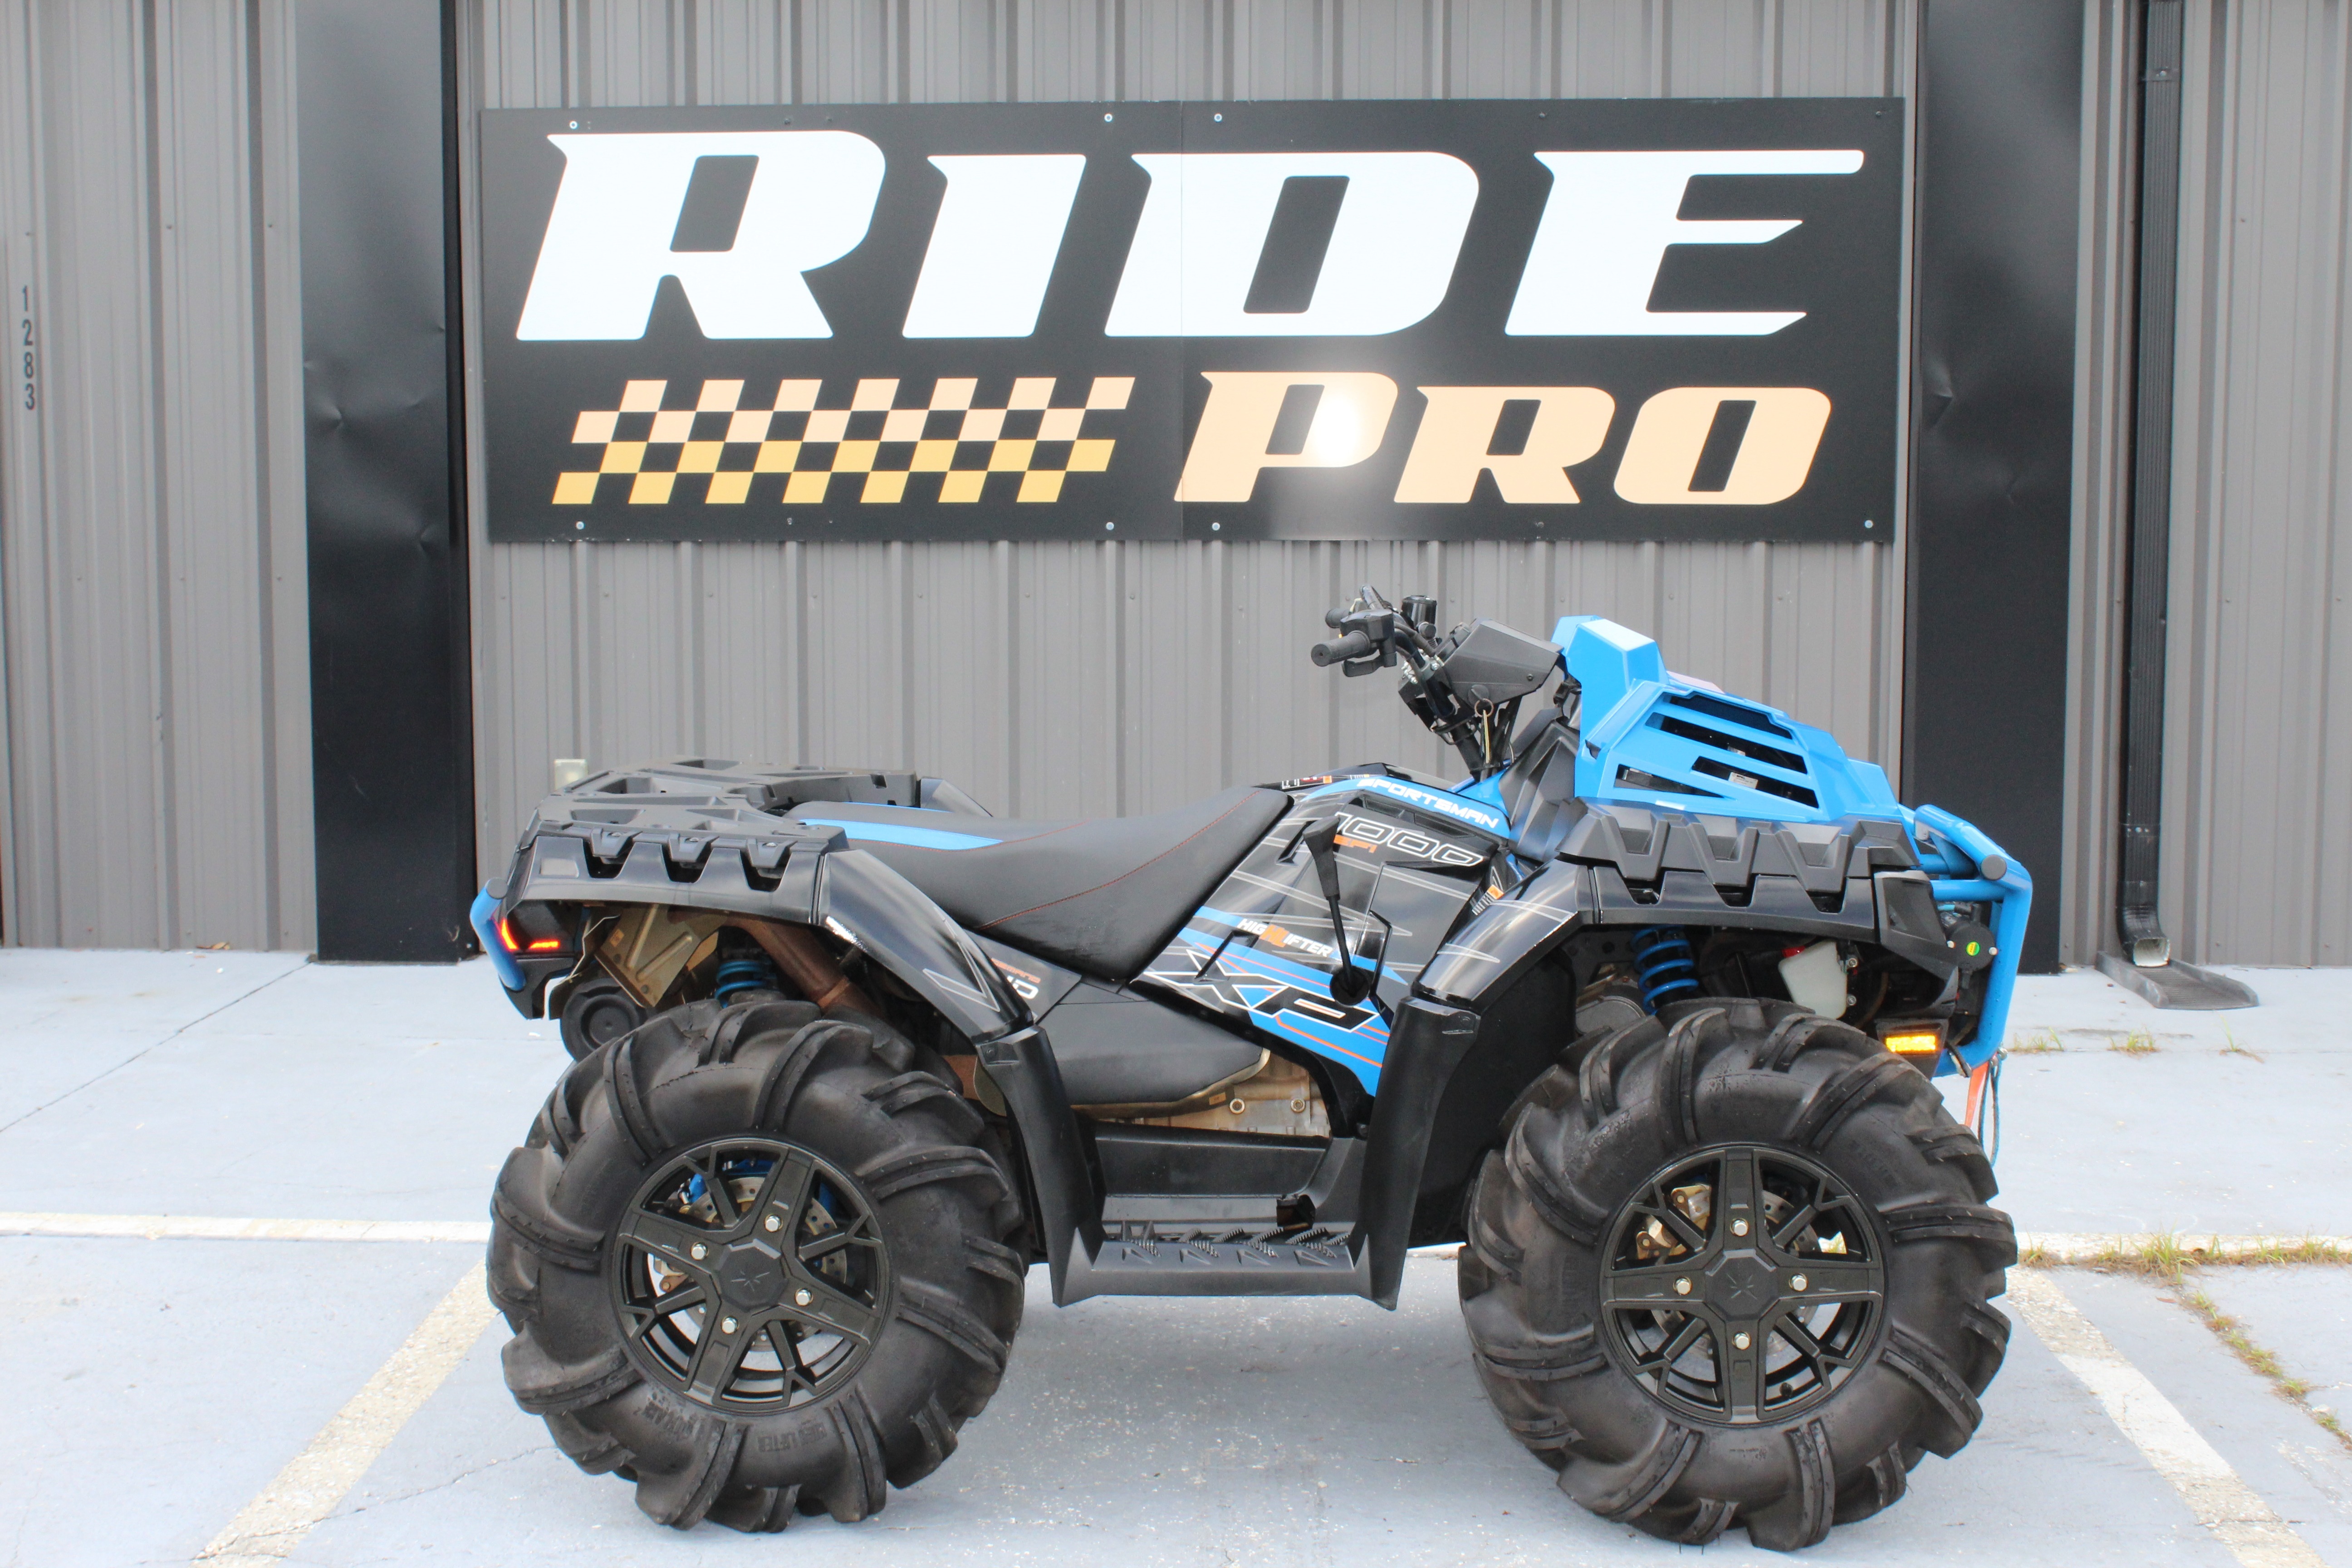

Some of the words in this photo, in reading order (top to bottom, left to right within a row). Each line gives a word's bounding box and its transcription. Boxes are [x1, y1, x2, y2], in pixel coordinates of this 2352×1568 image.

[516, 130, 1864, 341] RIDE
[22, 285, 35, 411] 1283
[1174, 371, 1832, 505] PRO
[1357, 778, 1499, 828] SPORTSMAN
